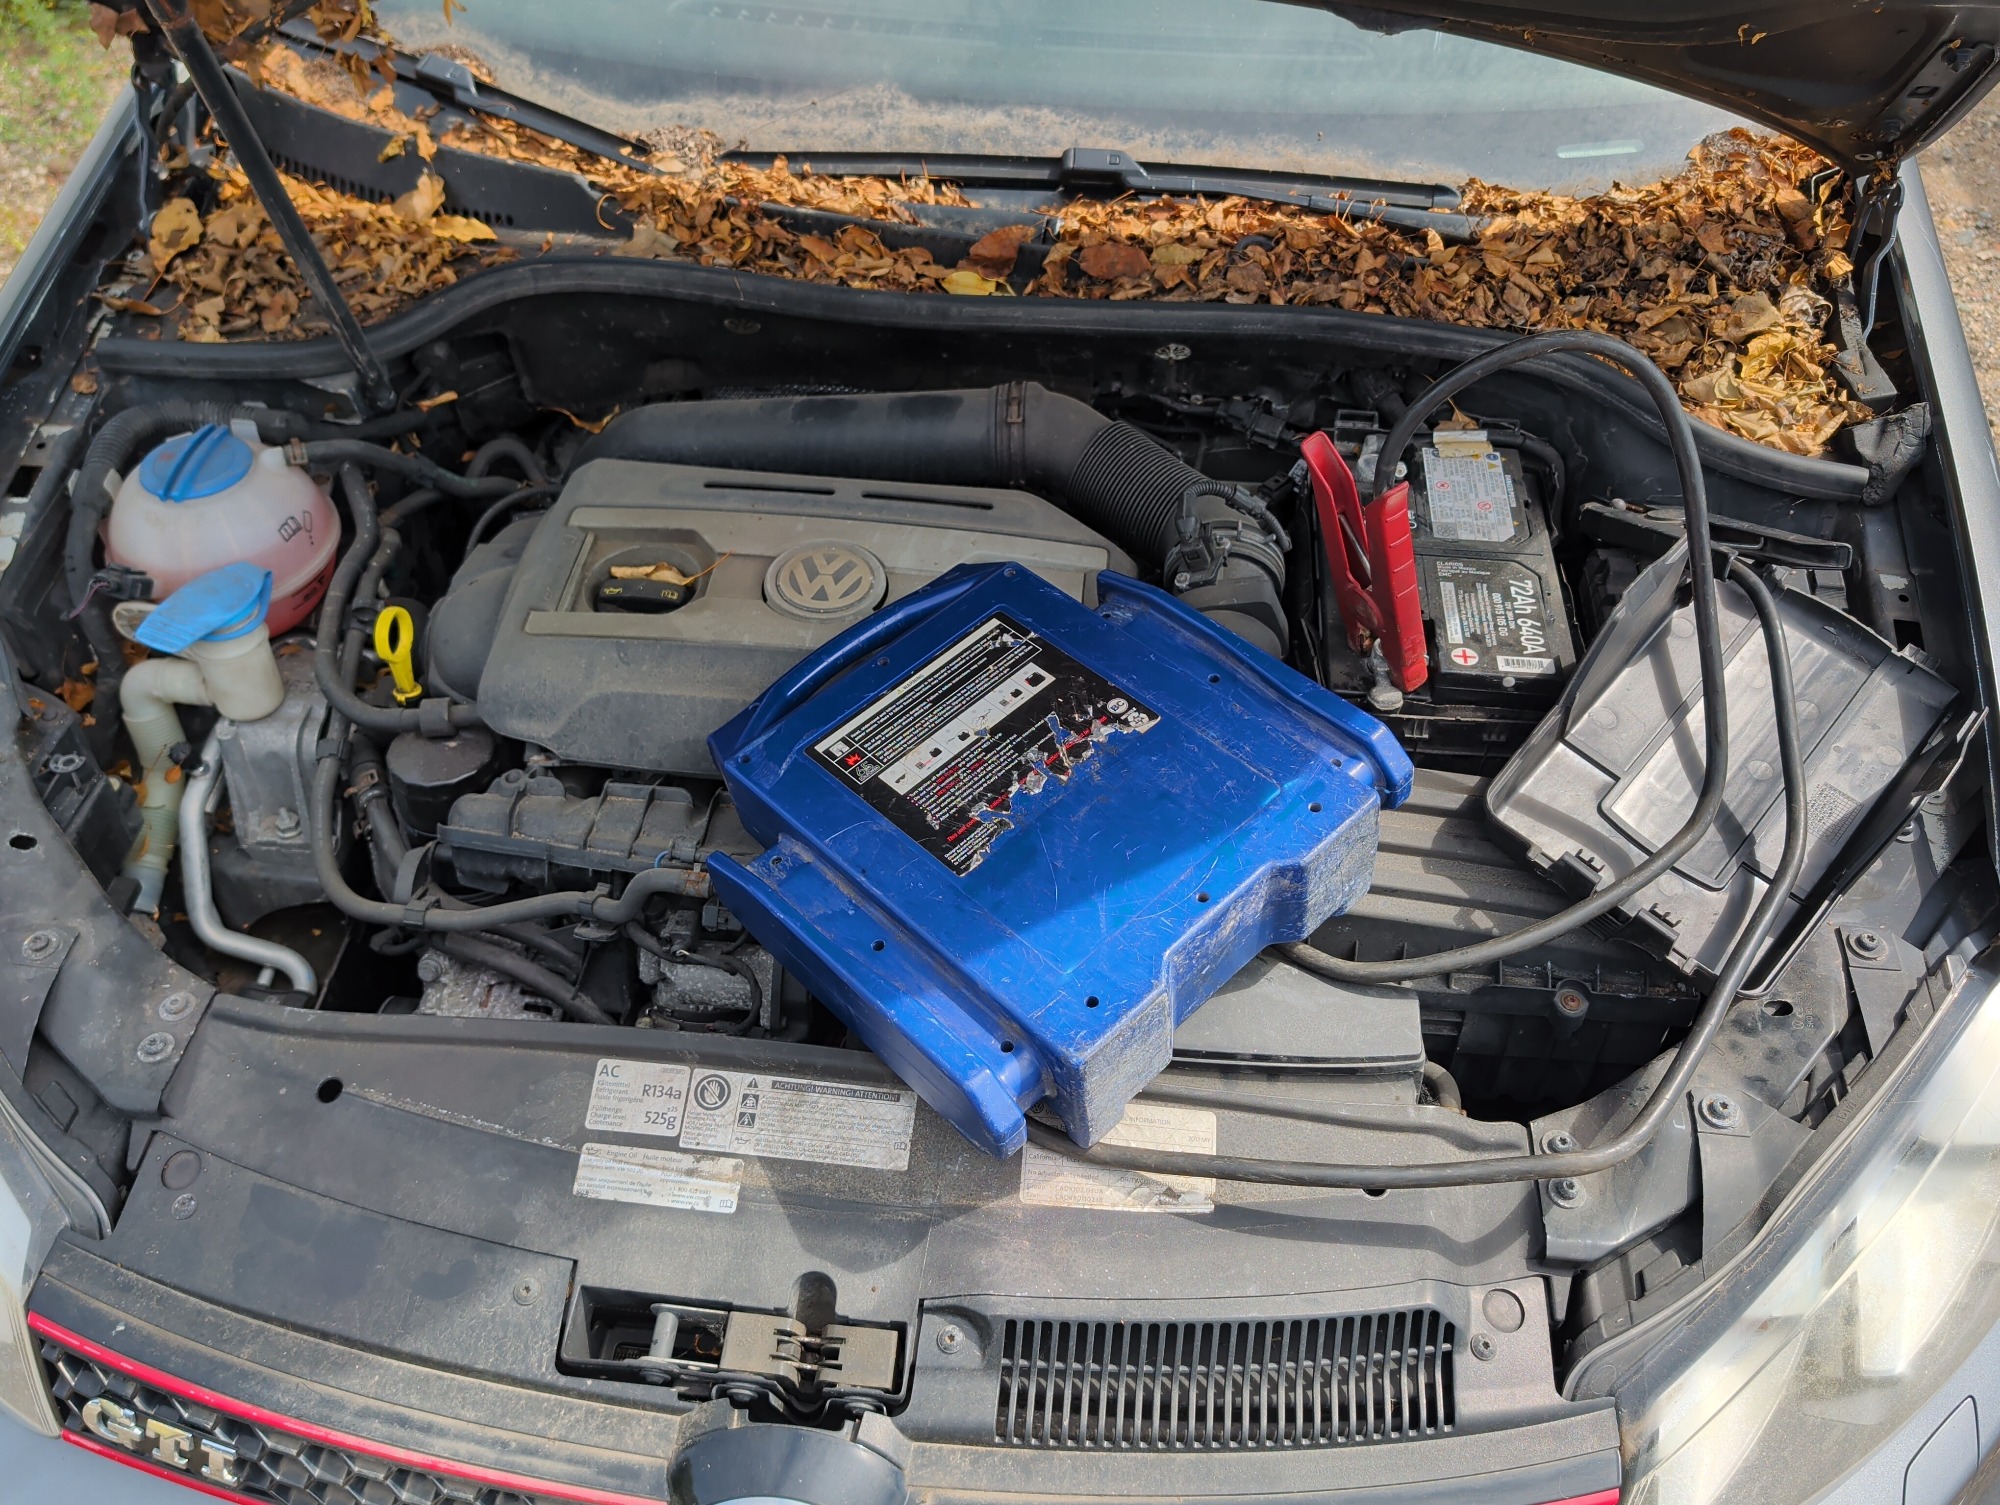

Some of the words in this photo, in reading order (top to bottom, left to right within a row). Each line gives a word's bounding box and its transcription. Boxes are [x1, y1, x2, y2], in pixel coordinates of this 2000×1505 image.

[1509, 580, 1537, 614] 72Ah
[1517, 618, 1546, 654] 640A
[901, 673, 925, 690] WARNING
[598, 1064, 620, 1077] AC
[595, 1087, 628, 1095] Refrigerant
[642, 1084, 682, 1099] R134a
[774, 1081, 814, 1092] ACHTUNG!
[815, 1085, 854, 1096] WARNING!
[855, 1090, 898, 1101] ATTENTION!
[590, 1112, 611, 1120] Charge
[612, 1112, 627, 1120] level
[644, 1110, 677, 1130] 525g
[1131, 1117, 1171, 1125] INFORMATION
[606, 1150, 628, 1159] Engine
[660, 1156, 683, 1164] moteur
[1029, 1153, 1057, 1161] California
[82, 1397, 238, 1487] GTI
